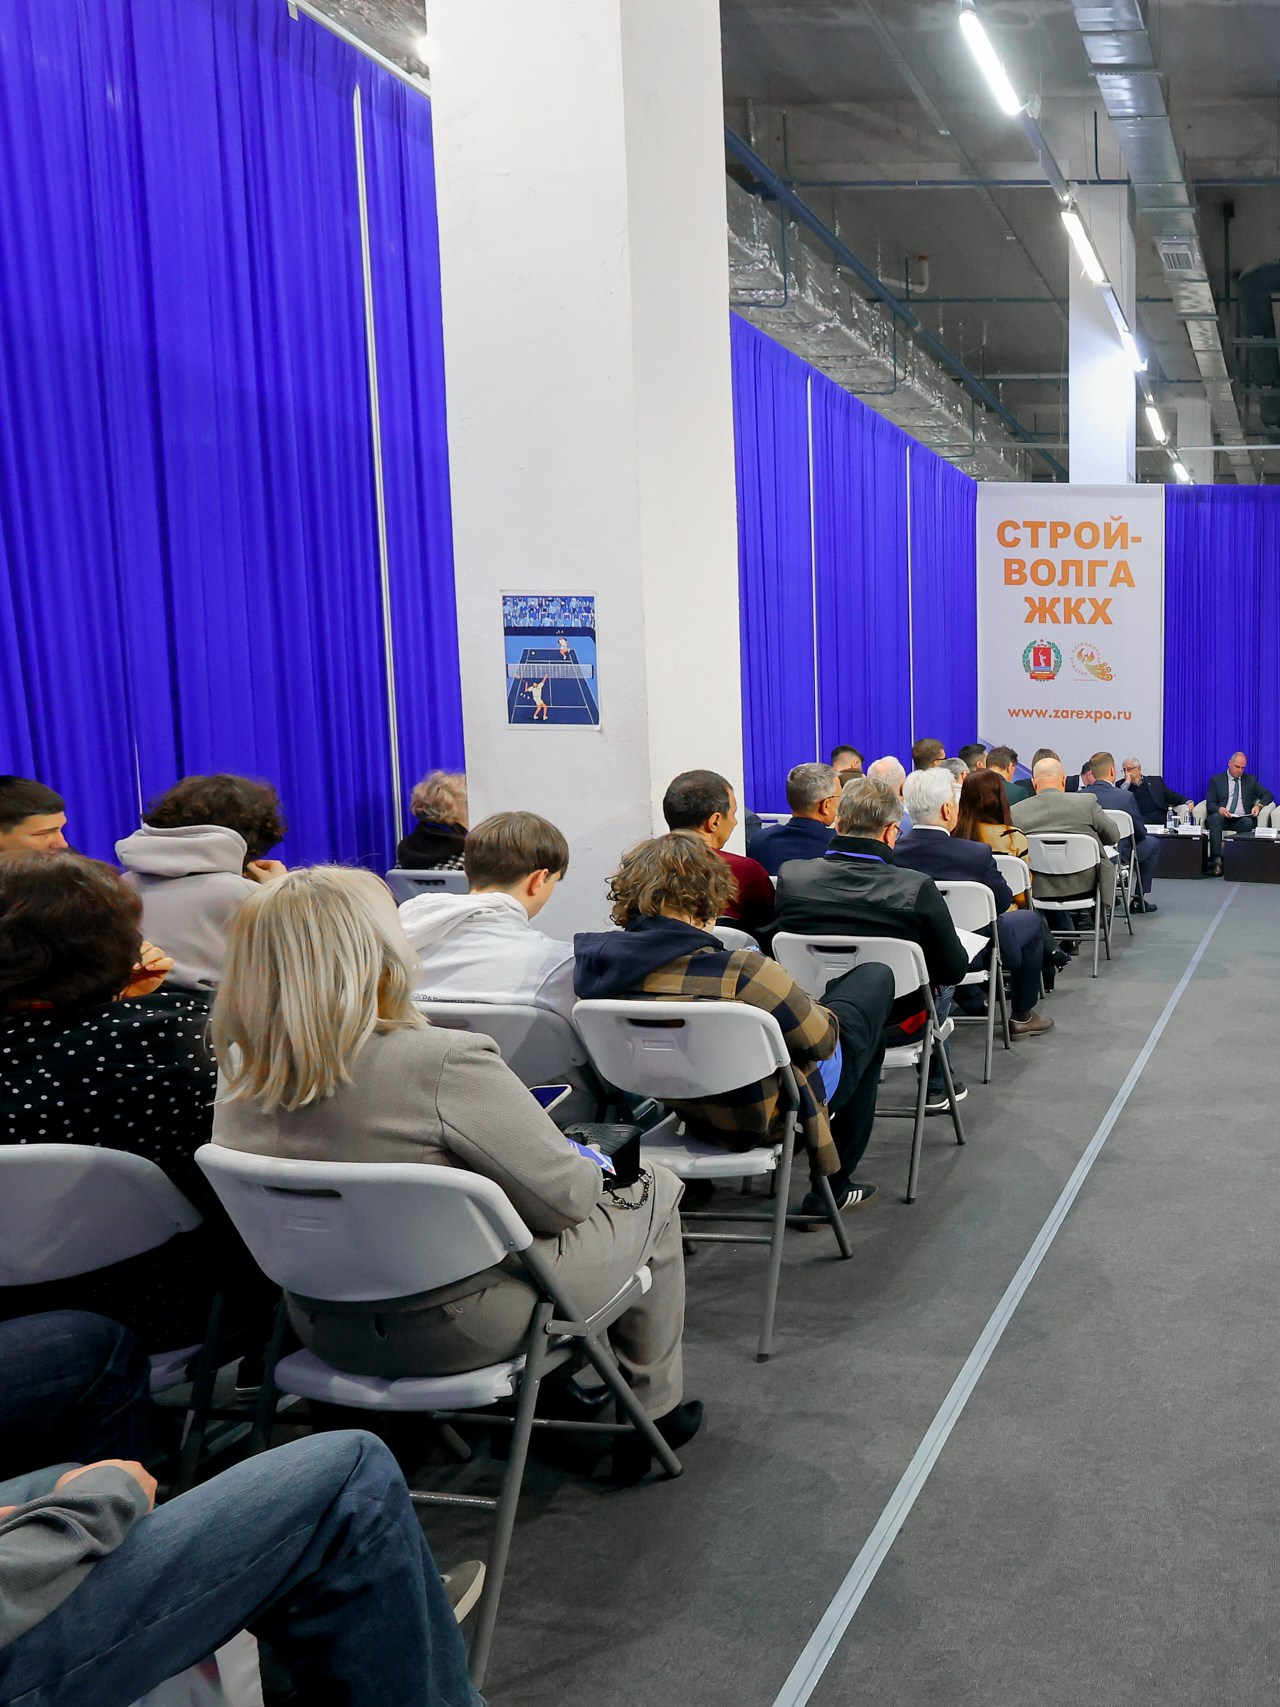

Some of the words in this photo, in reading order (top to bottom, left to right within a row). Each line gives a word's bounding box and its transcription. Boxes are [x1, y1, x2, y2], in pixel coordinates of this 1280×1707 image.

[996, 515, 1142, 550] СТРОЙ-
[1004, 558, 1136, 588] ВОЛГА
[1024, 596, 1113, 625] ЖКХ
[1008, 708, 1132, 723] www.zarexpo.ru
